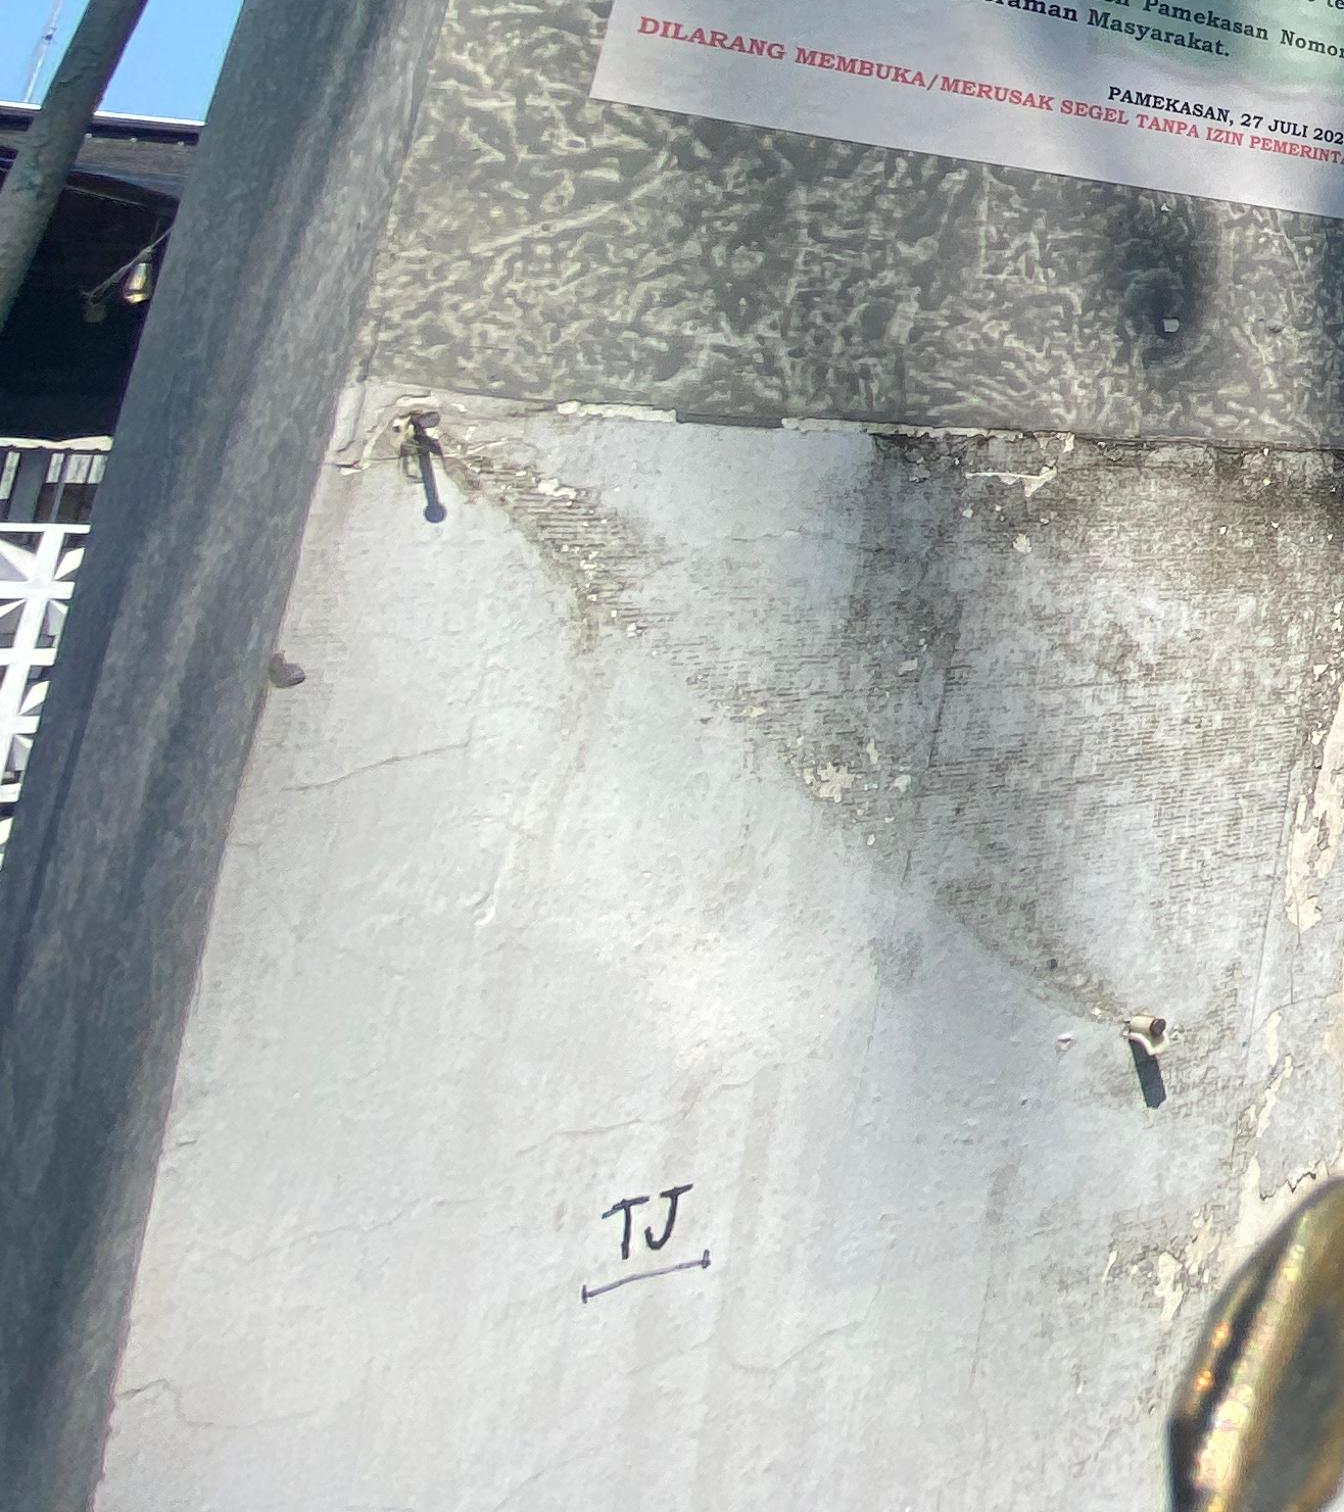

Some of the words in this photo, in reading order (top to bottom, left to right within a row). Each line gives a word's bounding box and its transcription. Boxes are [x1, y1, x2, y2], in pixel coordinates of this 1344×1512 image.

[1086, 8, 1230, 57] Masyarakat.
[638, 16, 786, 60] DILARANG
[794, 47, 1055, 111] MEMBUKA/MERUSAK
[1060, 99, 1129, 125] SEGEL
[1136, 113, 1199, 139] TANPA
[1205, 127, 1244, 146] IZIN
[1107, 85, 1234, 127] PAMEKASAN,
[1240, 113, 1264, 129] 27
[1267, 119, 1309, 139] JULI
[602, 1184, 693, 1260] TJ
